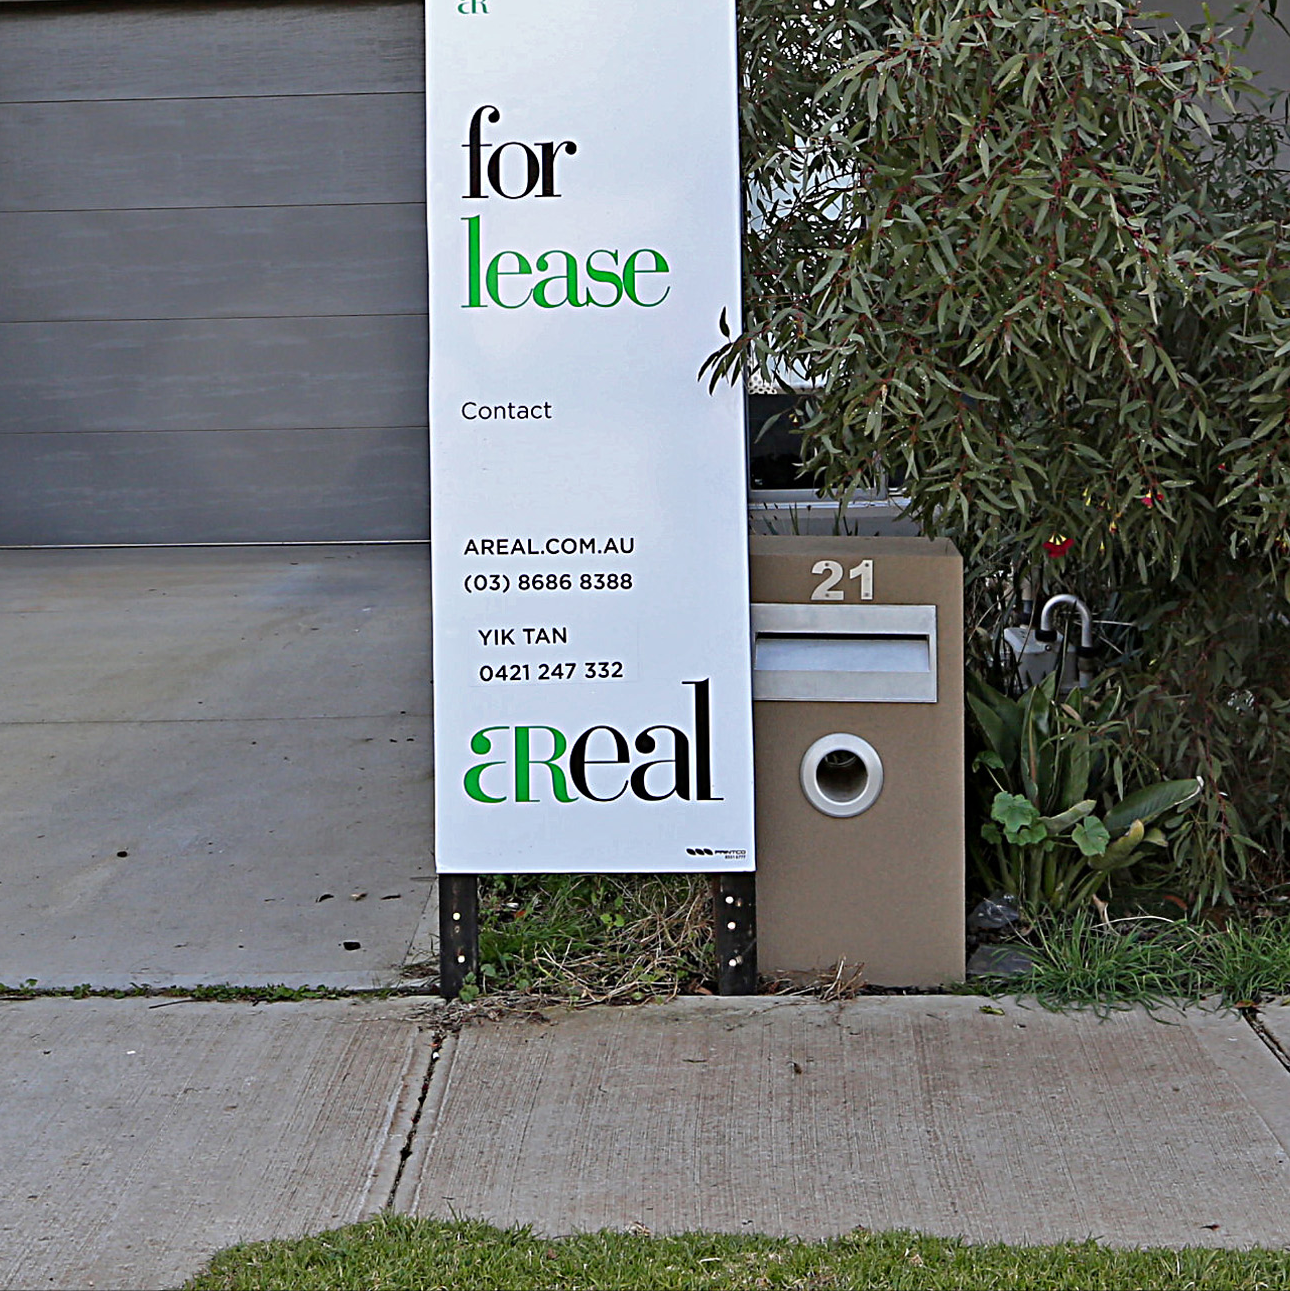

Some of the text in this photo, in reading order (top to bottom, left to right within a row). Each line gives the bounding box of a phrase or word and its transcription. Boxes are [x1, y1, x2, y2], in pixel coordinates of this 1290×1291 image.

[461, 105, 577, 199] for
[460, 215, 670, 309] lease
[461, 401, 552, 420] Contact
[464, 537, 635, 556] AREAL.COM.AU
[464, 572, 633, 594] (03) 8686 8388
[810, 559, 874, 601] 21
[478, 627, 567, 646] YIK TAN
[479, 661, 624, 682] 0421 247 332
